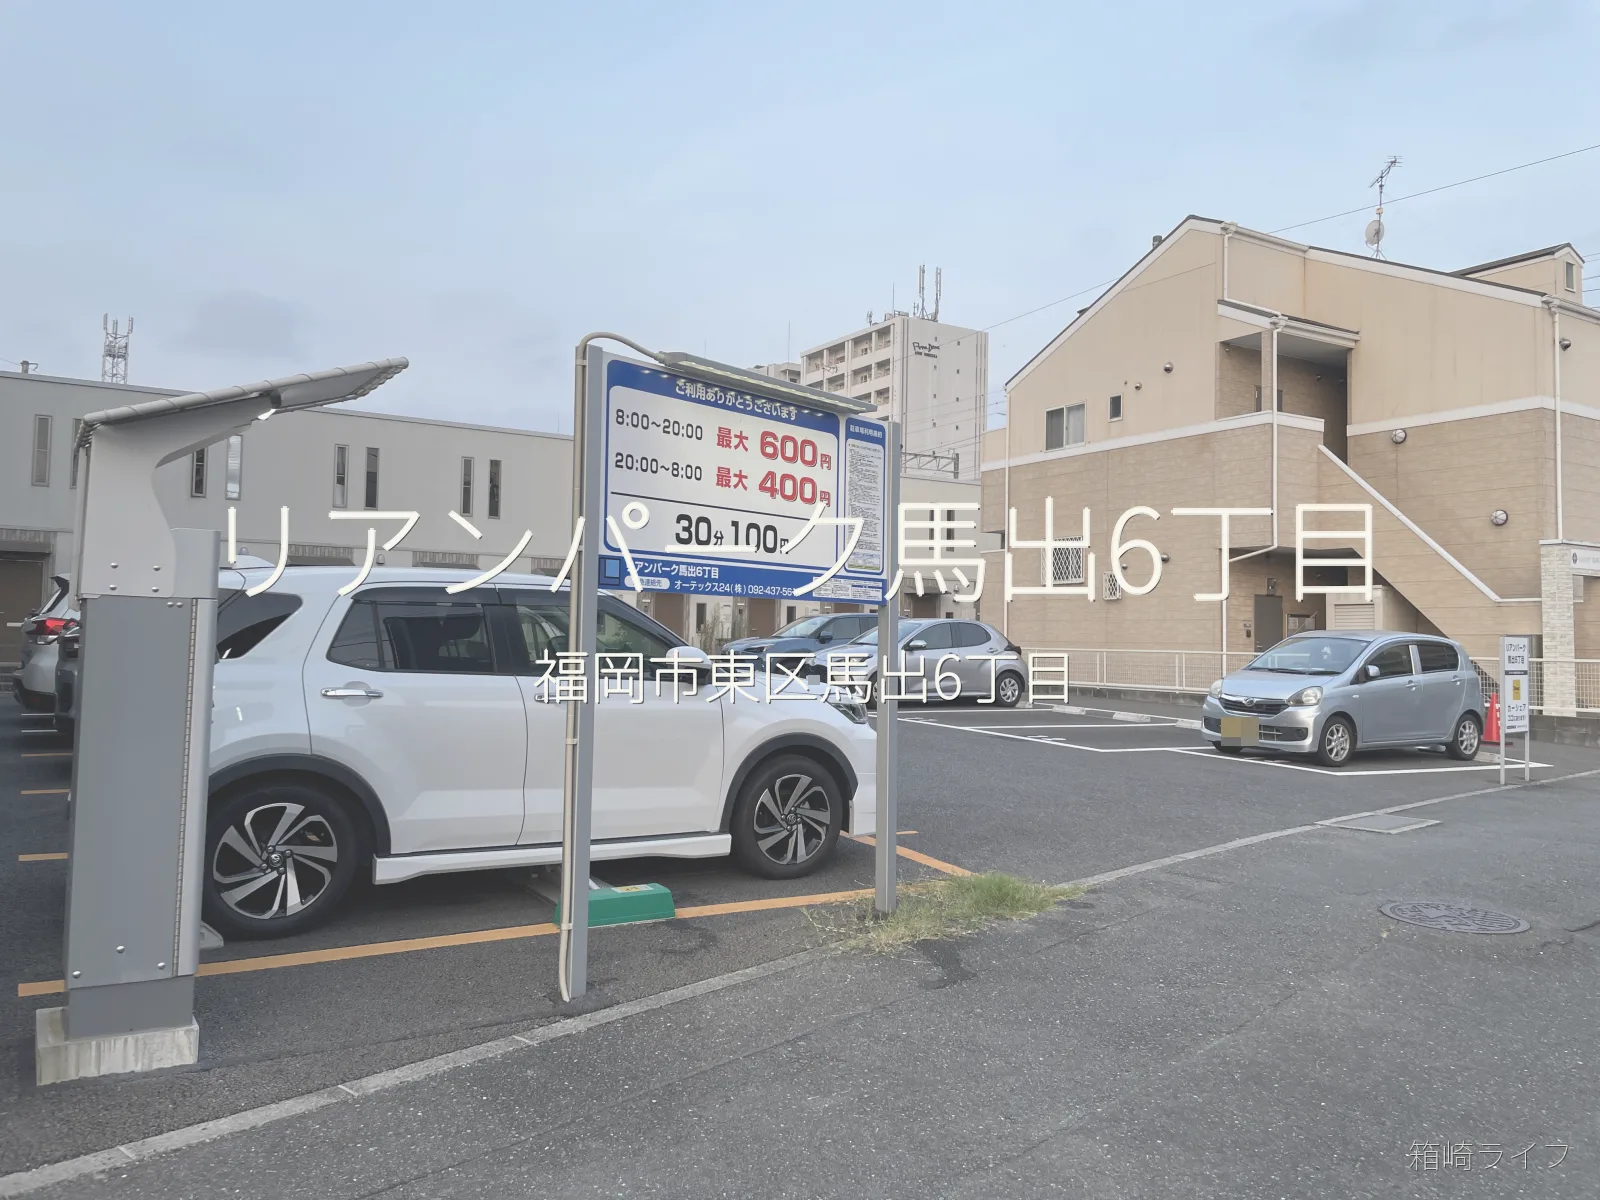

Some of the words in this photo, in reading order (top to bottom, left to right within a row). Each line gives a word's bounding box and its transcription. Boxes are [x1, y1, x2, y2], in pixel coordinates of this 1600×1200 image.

[675, 379, 798, 421] ご利用ありがとうございます
[716, 426, 749, 452] 最大
[715, 466, 748, 491] 最大
[627, 561, 719, 579] アンパーク馬出6丁目
